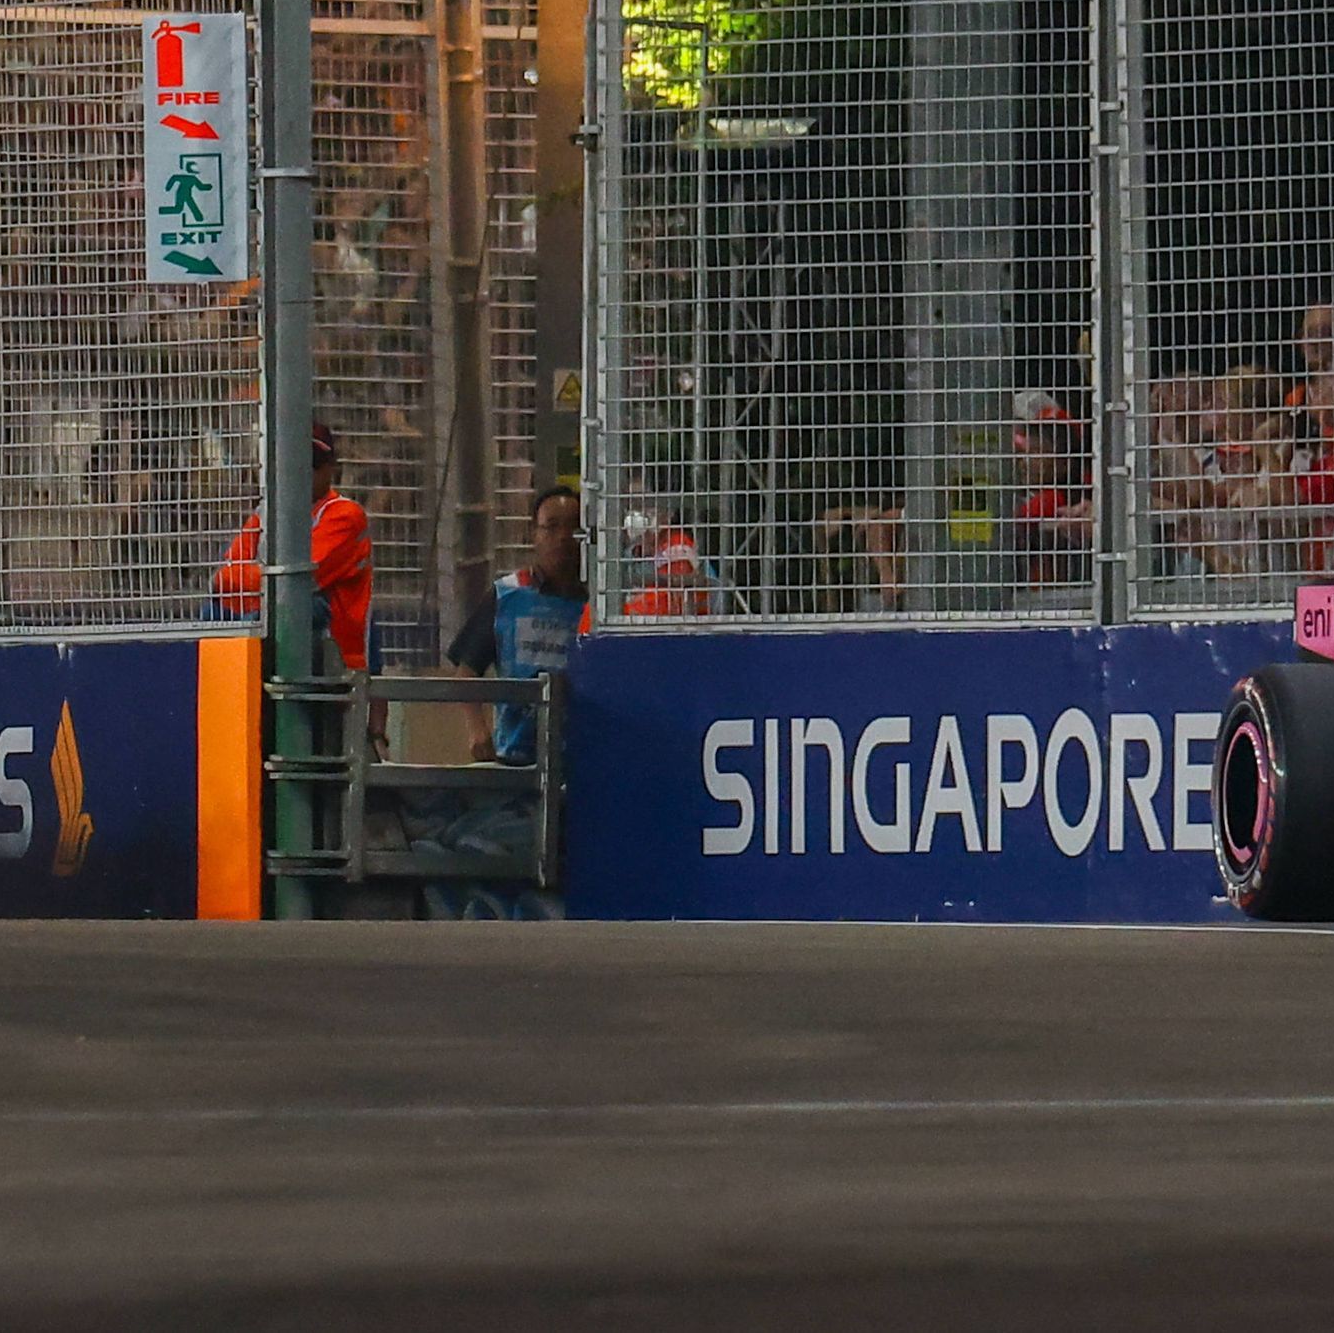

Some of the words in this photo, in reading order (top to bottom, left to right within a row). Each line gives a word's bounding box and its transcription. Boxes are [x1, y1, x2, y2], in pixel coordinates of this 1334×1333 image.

[157, 91, 221, 105] FIRE
[161, 231, 222, 245] EXIT
[1303, 596, 1331, 639] eni
[702, 707, 1223, 856] SINGAPORE
